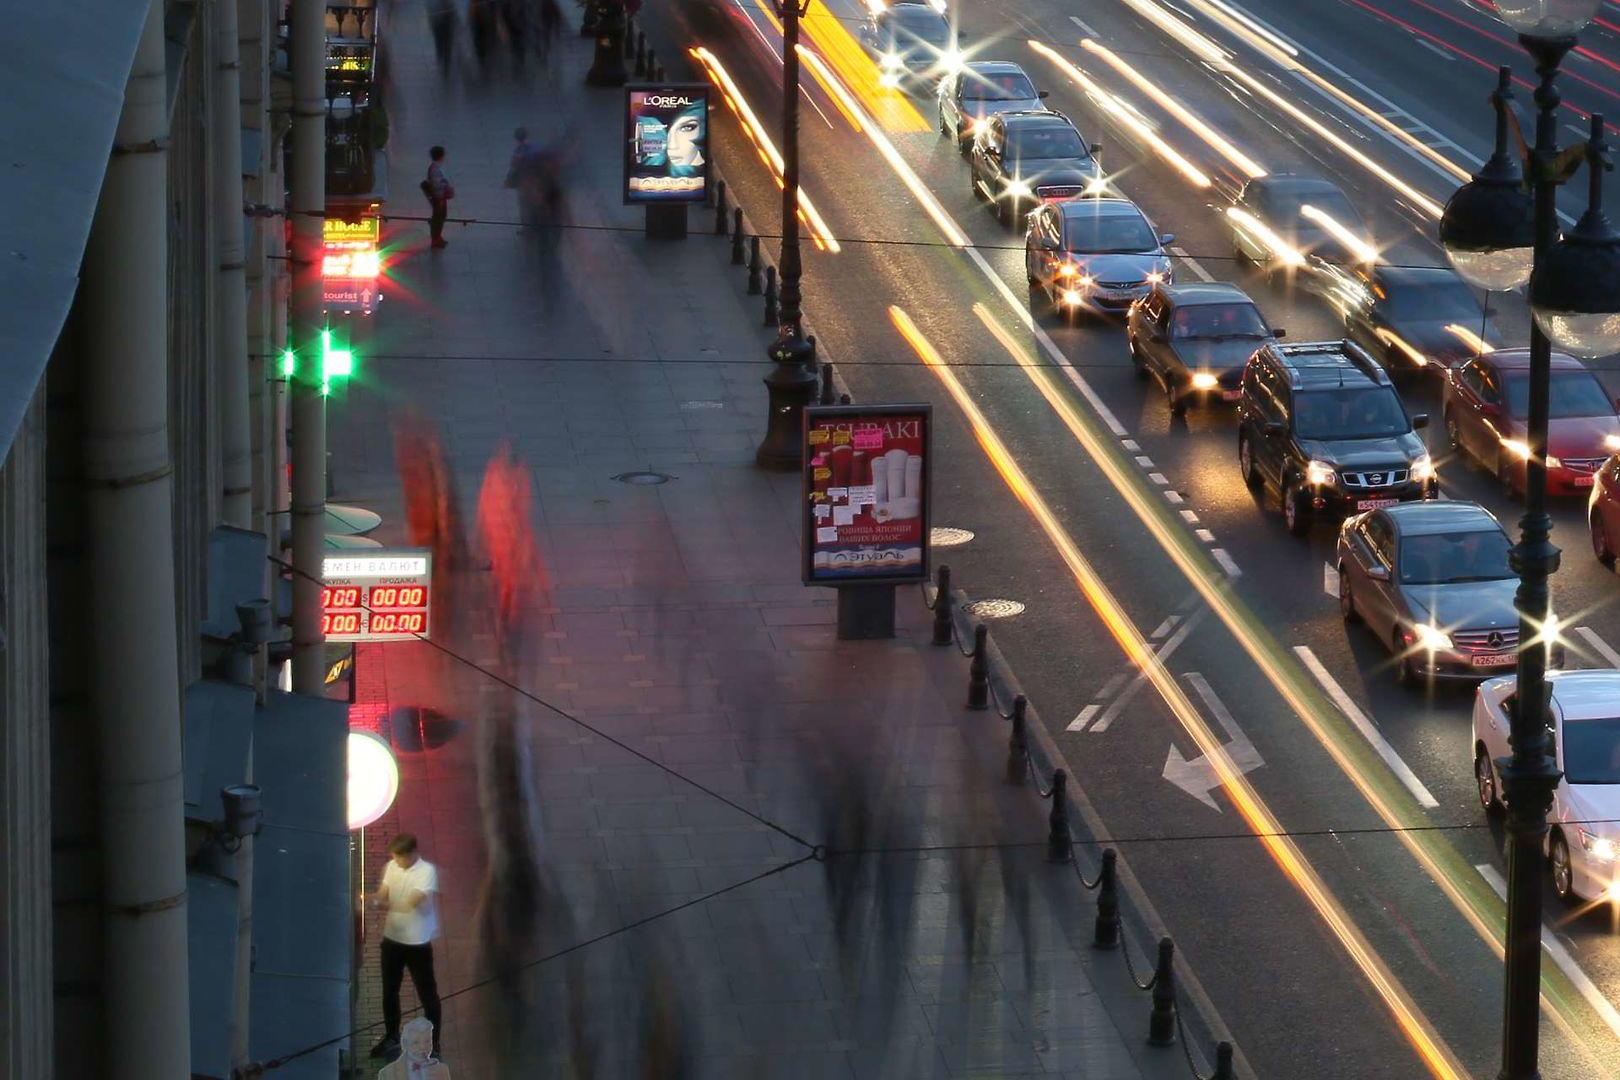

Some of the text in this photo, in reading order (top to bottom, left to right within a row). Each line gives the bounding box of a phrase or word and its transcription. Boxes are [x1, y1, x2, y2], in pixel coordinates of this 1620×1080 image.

[324, 292, 358, 300] tourist
[368, 560, 419, 572] ВАЛЮТ
[379, 577, 417, 585] ПРОДАЖА
